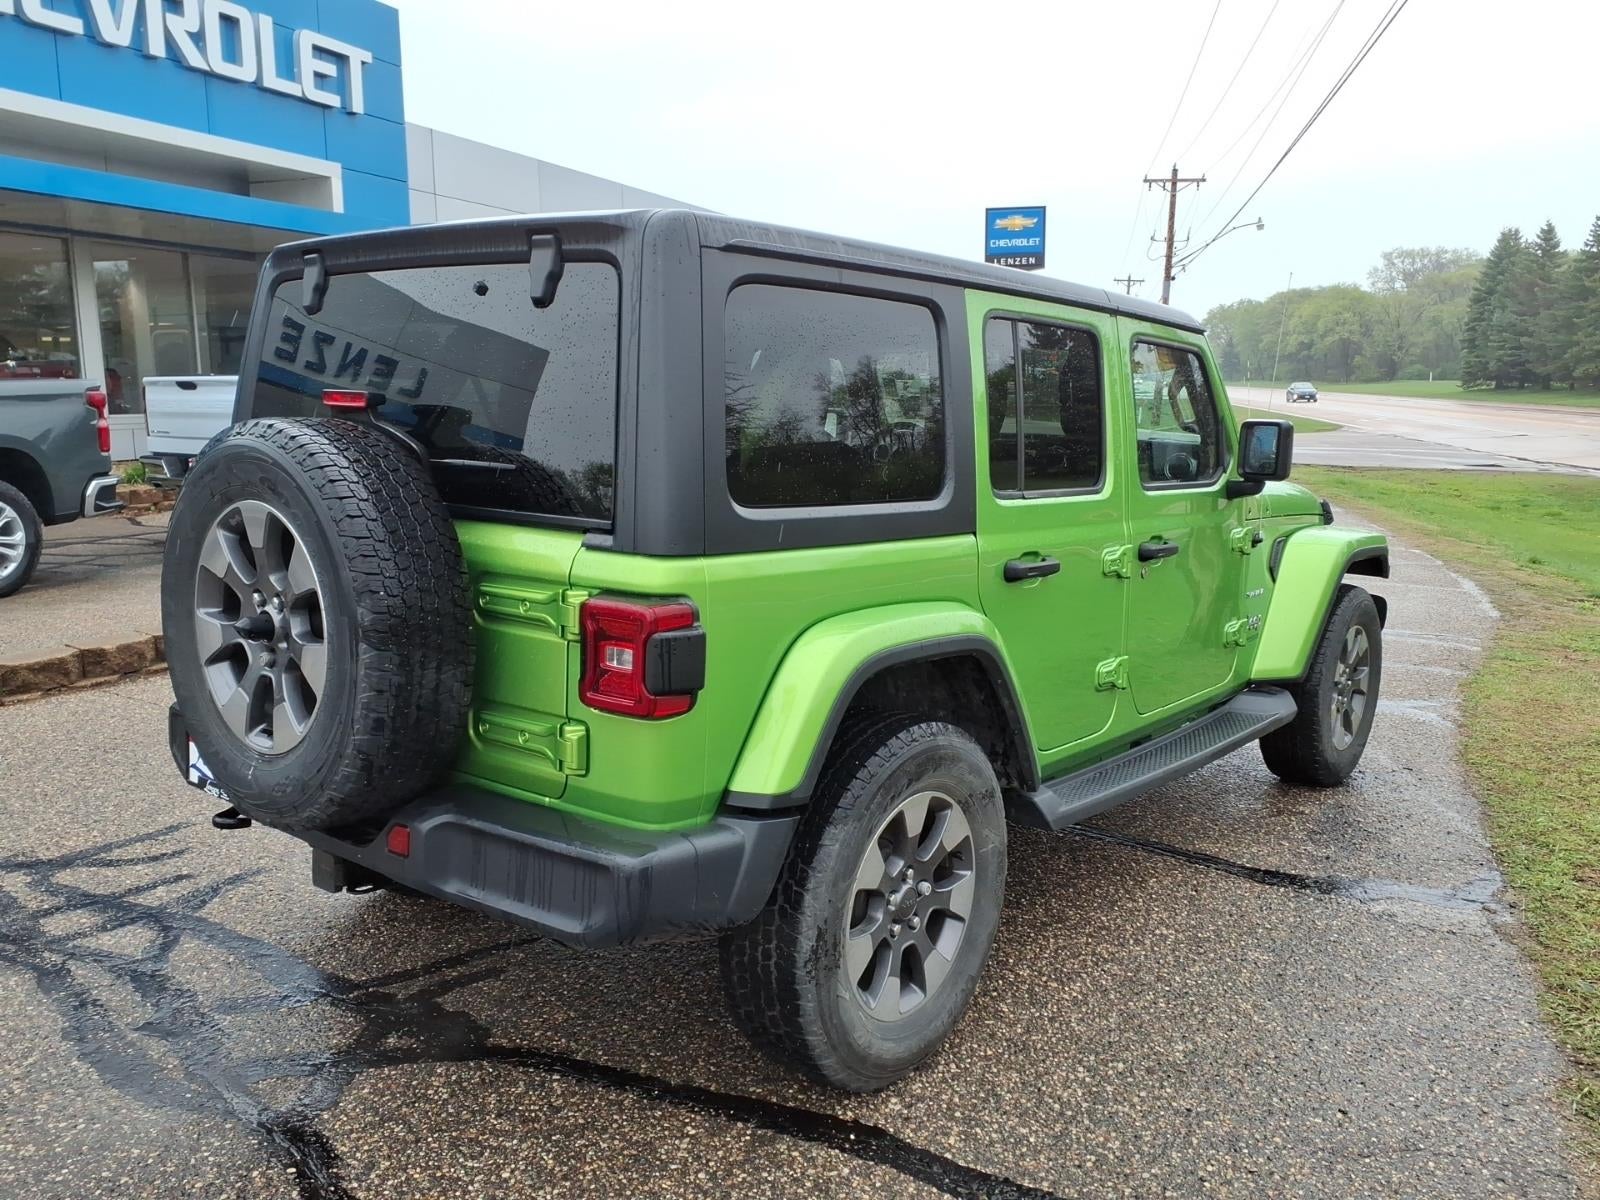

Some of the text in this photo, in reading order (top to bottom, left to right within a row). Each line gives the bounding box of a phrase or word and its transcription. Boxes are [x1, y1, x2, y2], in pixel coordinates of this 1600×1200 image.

[0, 0, 373, 115] VROLET
[990, 237, 1041, 248] CHEVROLET
[993, 256, 1036, 266] LENZEN
